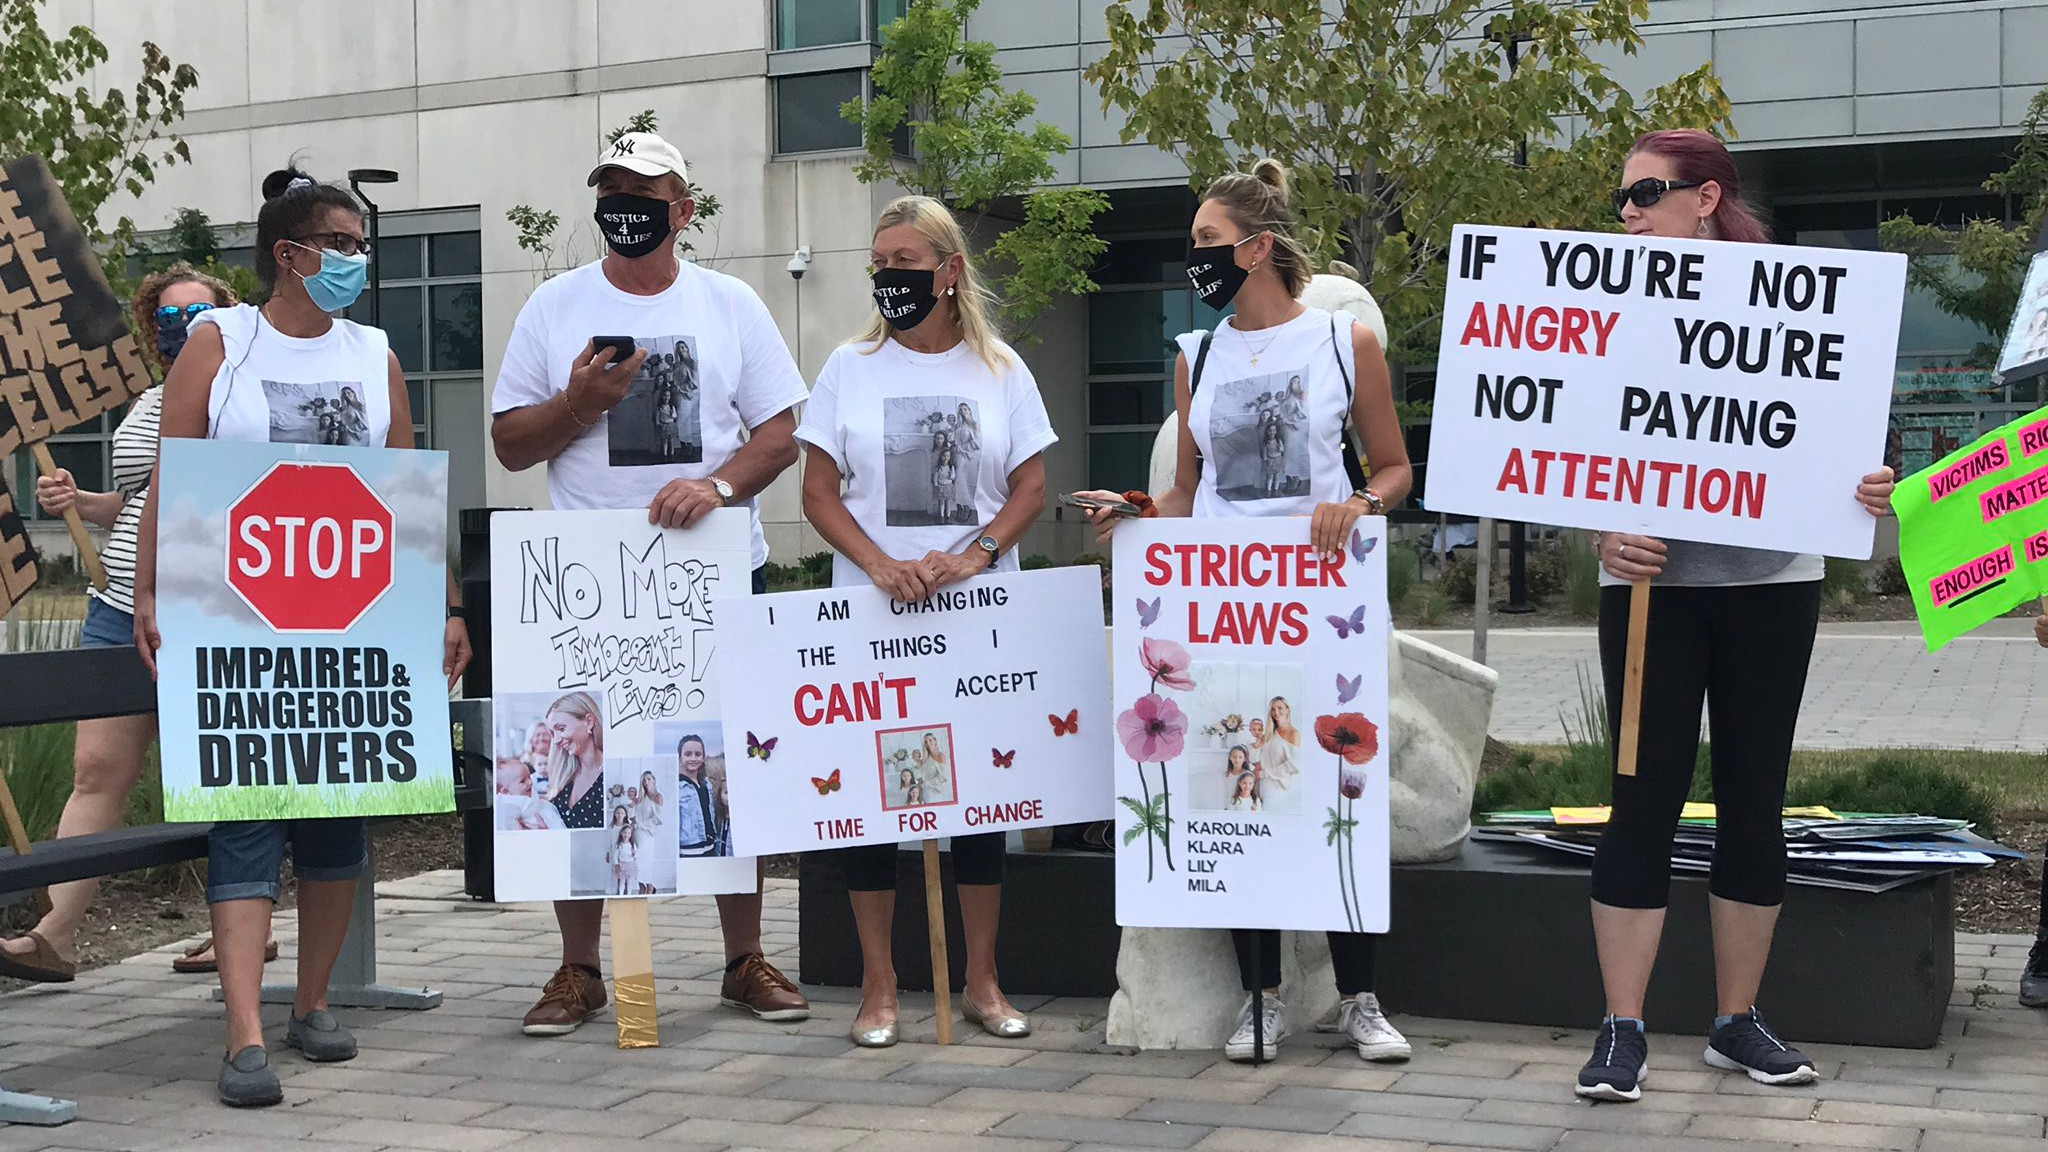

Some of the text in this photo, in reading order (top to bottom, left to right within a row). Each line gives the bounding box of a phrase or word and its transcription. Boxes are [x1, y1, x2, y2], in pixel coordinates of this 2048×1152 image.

[611, 139, 635, 158] NY
[618, 224, 628, 235] 4
[1459, 233, 1848, 315] IF YOU'RE NOT
[883, 298, 891, 309] 4
[1459, 301, 1845, 381] ANGRY YOU'RE
[1474, 373, 1797, 449] NOT PAYING
[1496, 447, 1767, 520] ATTENTION
[1933, 445, 2006, 498] VICTIMS
[237, 515, 384, 579] STOP
[1144, 542, 1348, 588] STRICTER
[1934, 551, 2011, 602] ENOUGH
[768, 586, 1009, 625] I AM CHANGING
[1188, 601, 1309, 647] LAWS
[196, 647, 388, 689] IMPAIRED
[797, 629, 998, 668] THE THINGS I
[197, 690, 413, 730] DANGEROUS
[793, 671, 1038, 727] CAN'T ACCEPT
[199, 730, 417, 787] DRIVERS
[814, 800, 1043, 840] TIME FOR CHANGE
[1187, 821, 1272, 838] KAROLINA
[1187, 840, 1244, 856] KLARA
[1187, 859, 1218, 874] LILY
[1187, 878, 1227, 893] MILA
